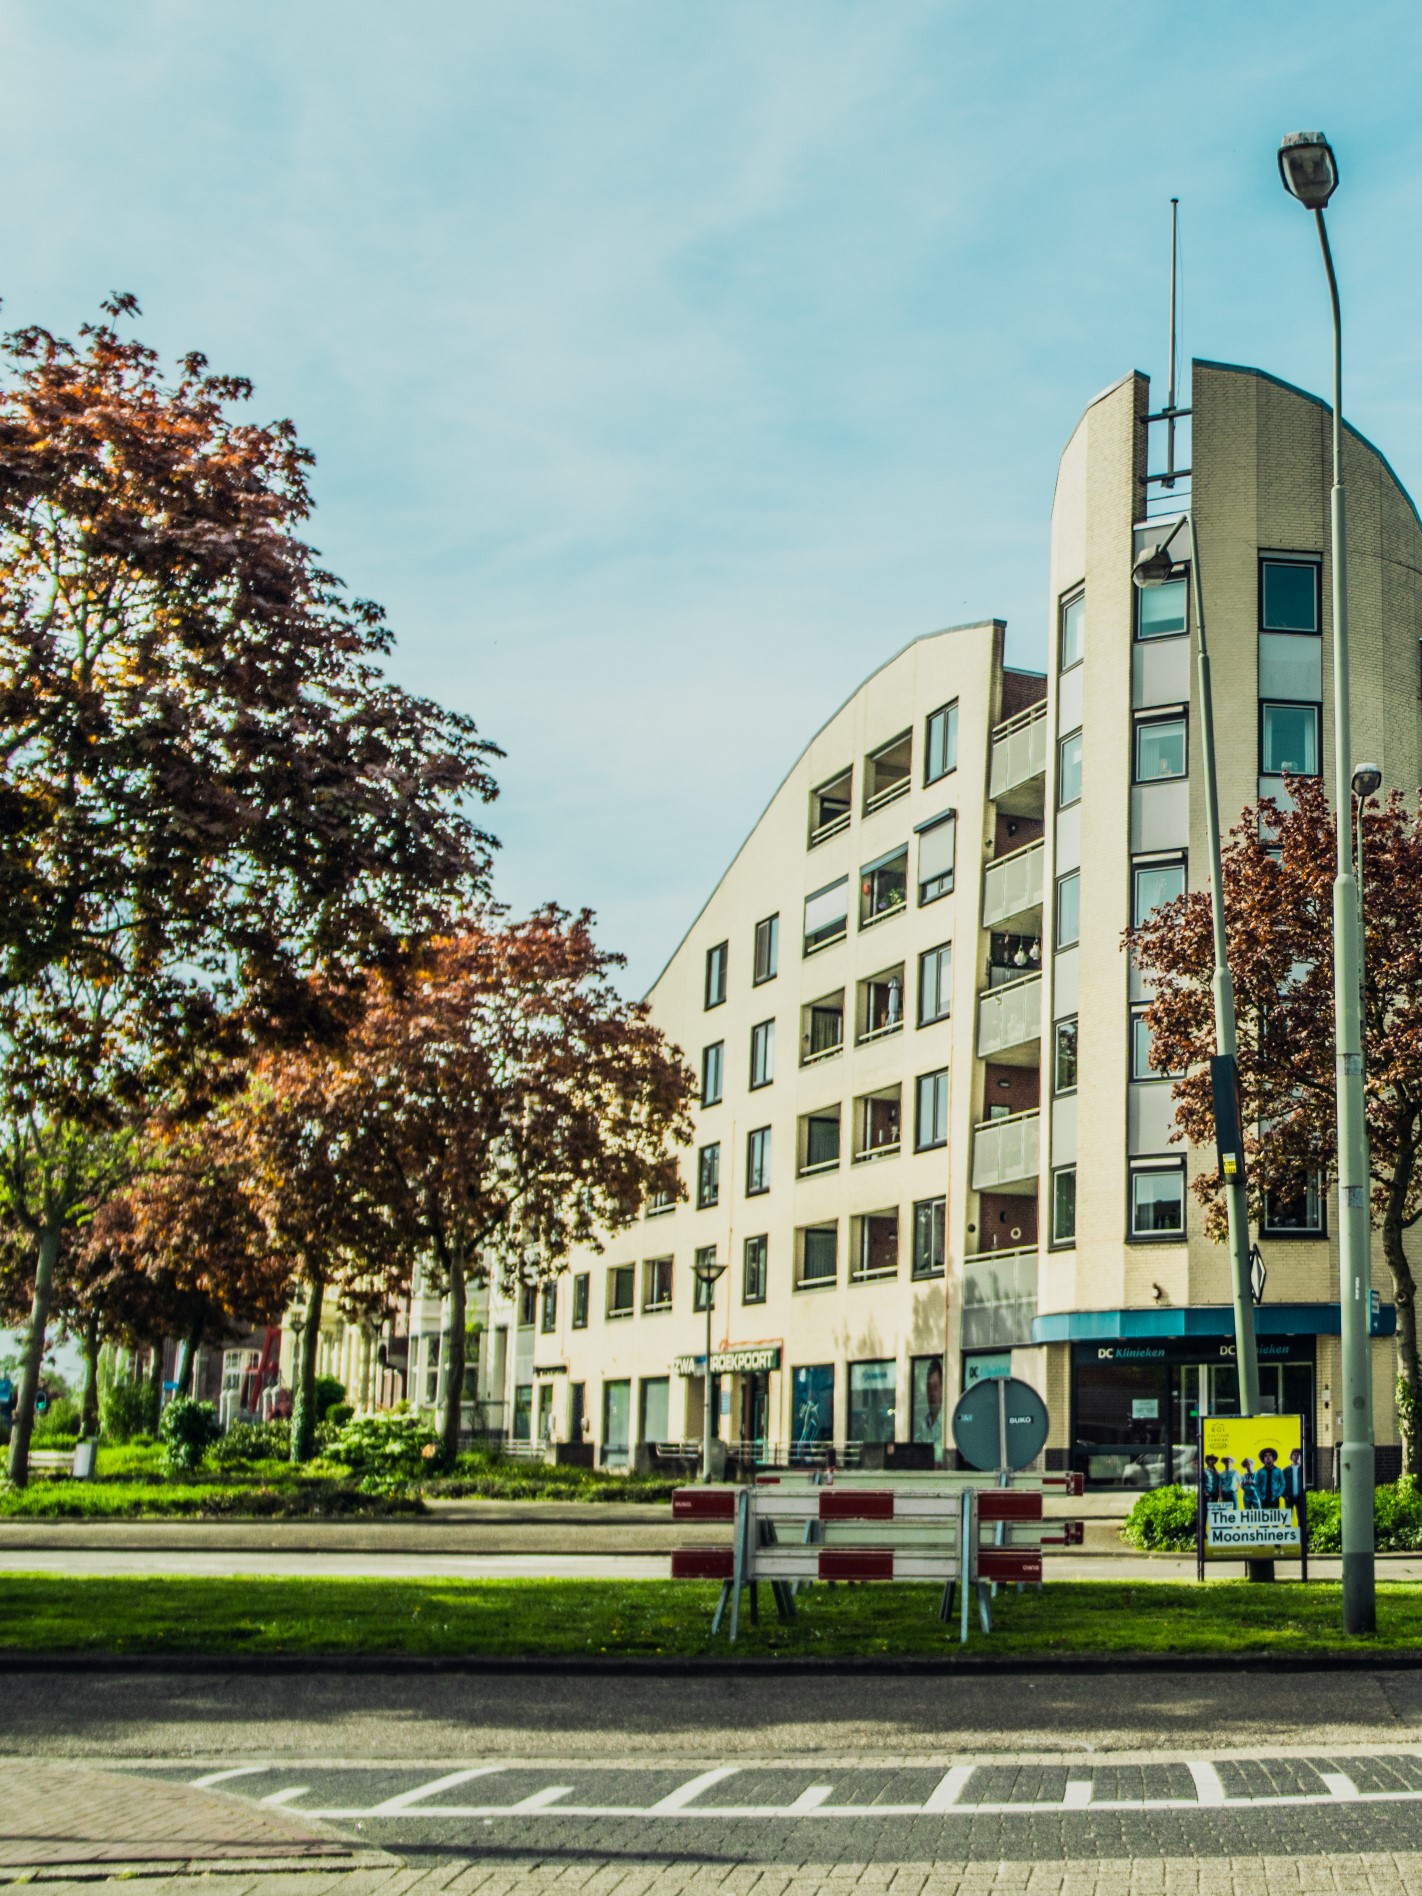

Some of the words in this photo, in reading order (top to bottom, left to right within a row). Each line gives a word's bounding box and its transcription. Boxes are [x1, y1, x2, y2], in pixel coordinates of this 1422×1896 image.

[1097, 1348, 1114, 1358] DC
[1115, 1347, 1165, 1358] Klinieken
[1219, 1345, 1235, 1355] DC
[1009, 1416, 1032, 1424] BUKO
[1211, 1511, 1236, 1523] The
[1240, 1510, 1288, 1524] Hillbilly
[1212, 1529, 1296, 1542] Moonshiners
